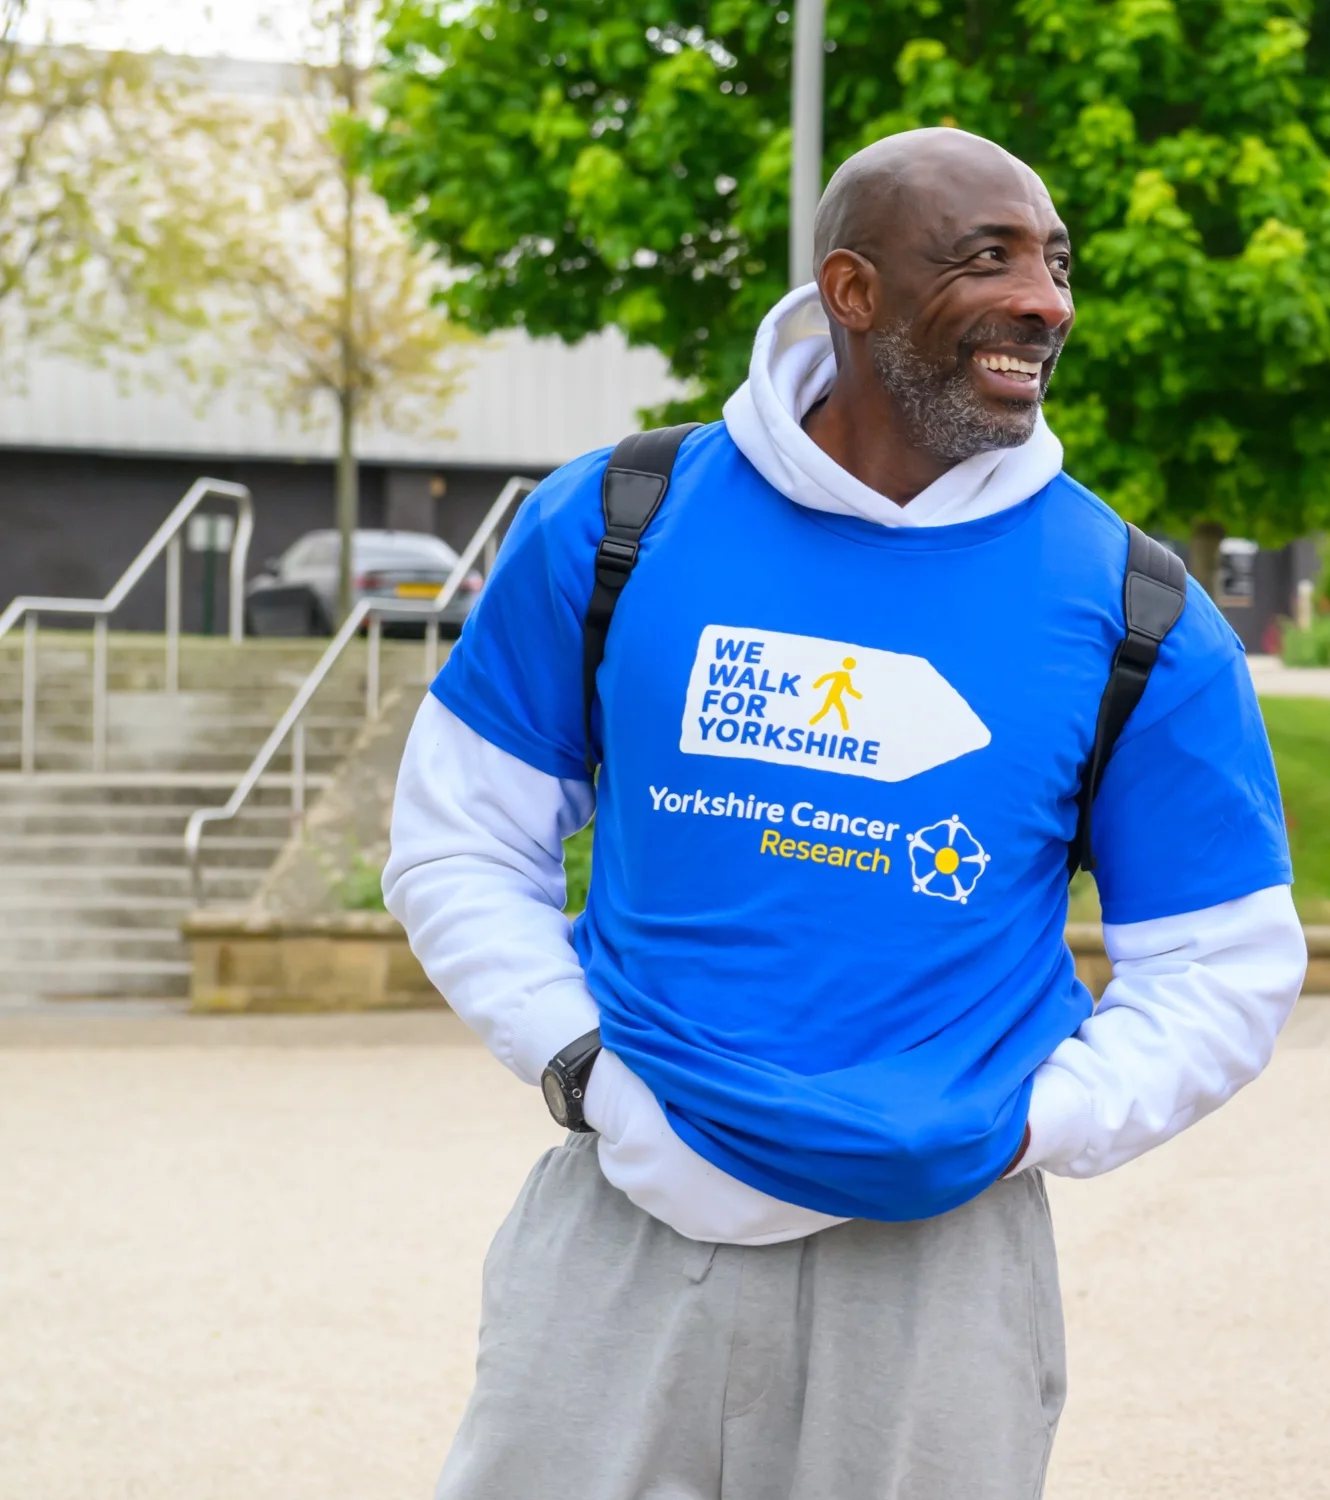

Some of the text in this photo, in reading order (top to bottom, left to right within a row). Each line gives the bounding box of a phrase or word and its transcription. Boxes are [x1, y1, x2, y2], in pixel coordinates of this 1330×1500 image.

[716, 638, 765, 665] WE
[708, 663, 801, 697] WALK
[701, 690, 768, 718] FOR
[697, 716, 881, 765] YORKSHIRE
[649, 785, 900, 842] Yorkshire Cancer
[760, 829, 891, 874] Research
